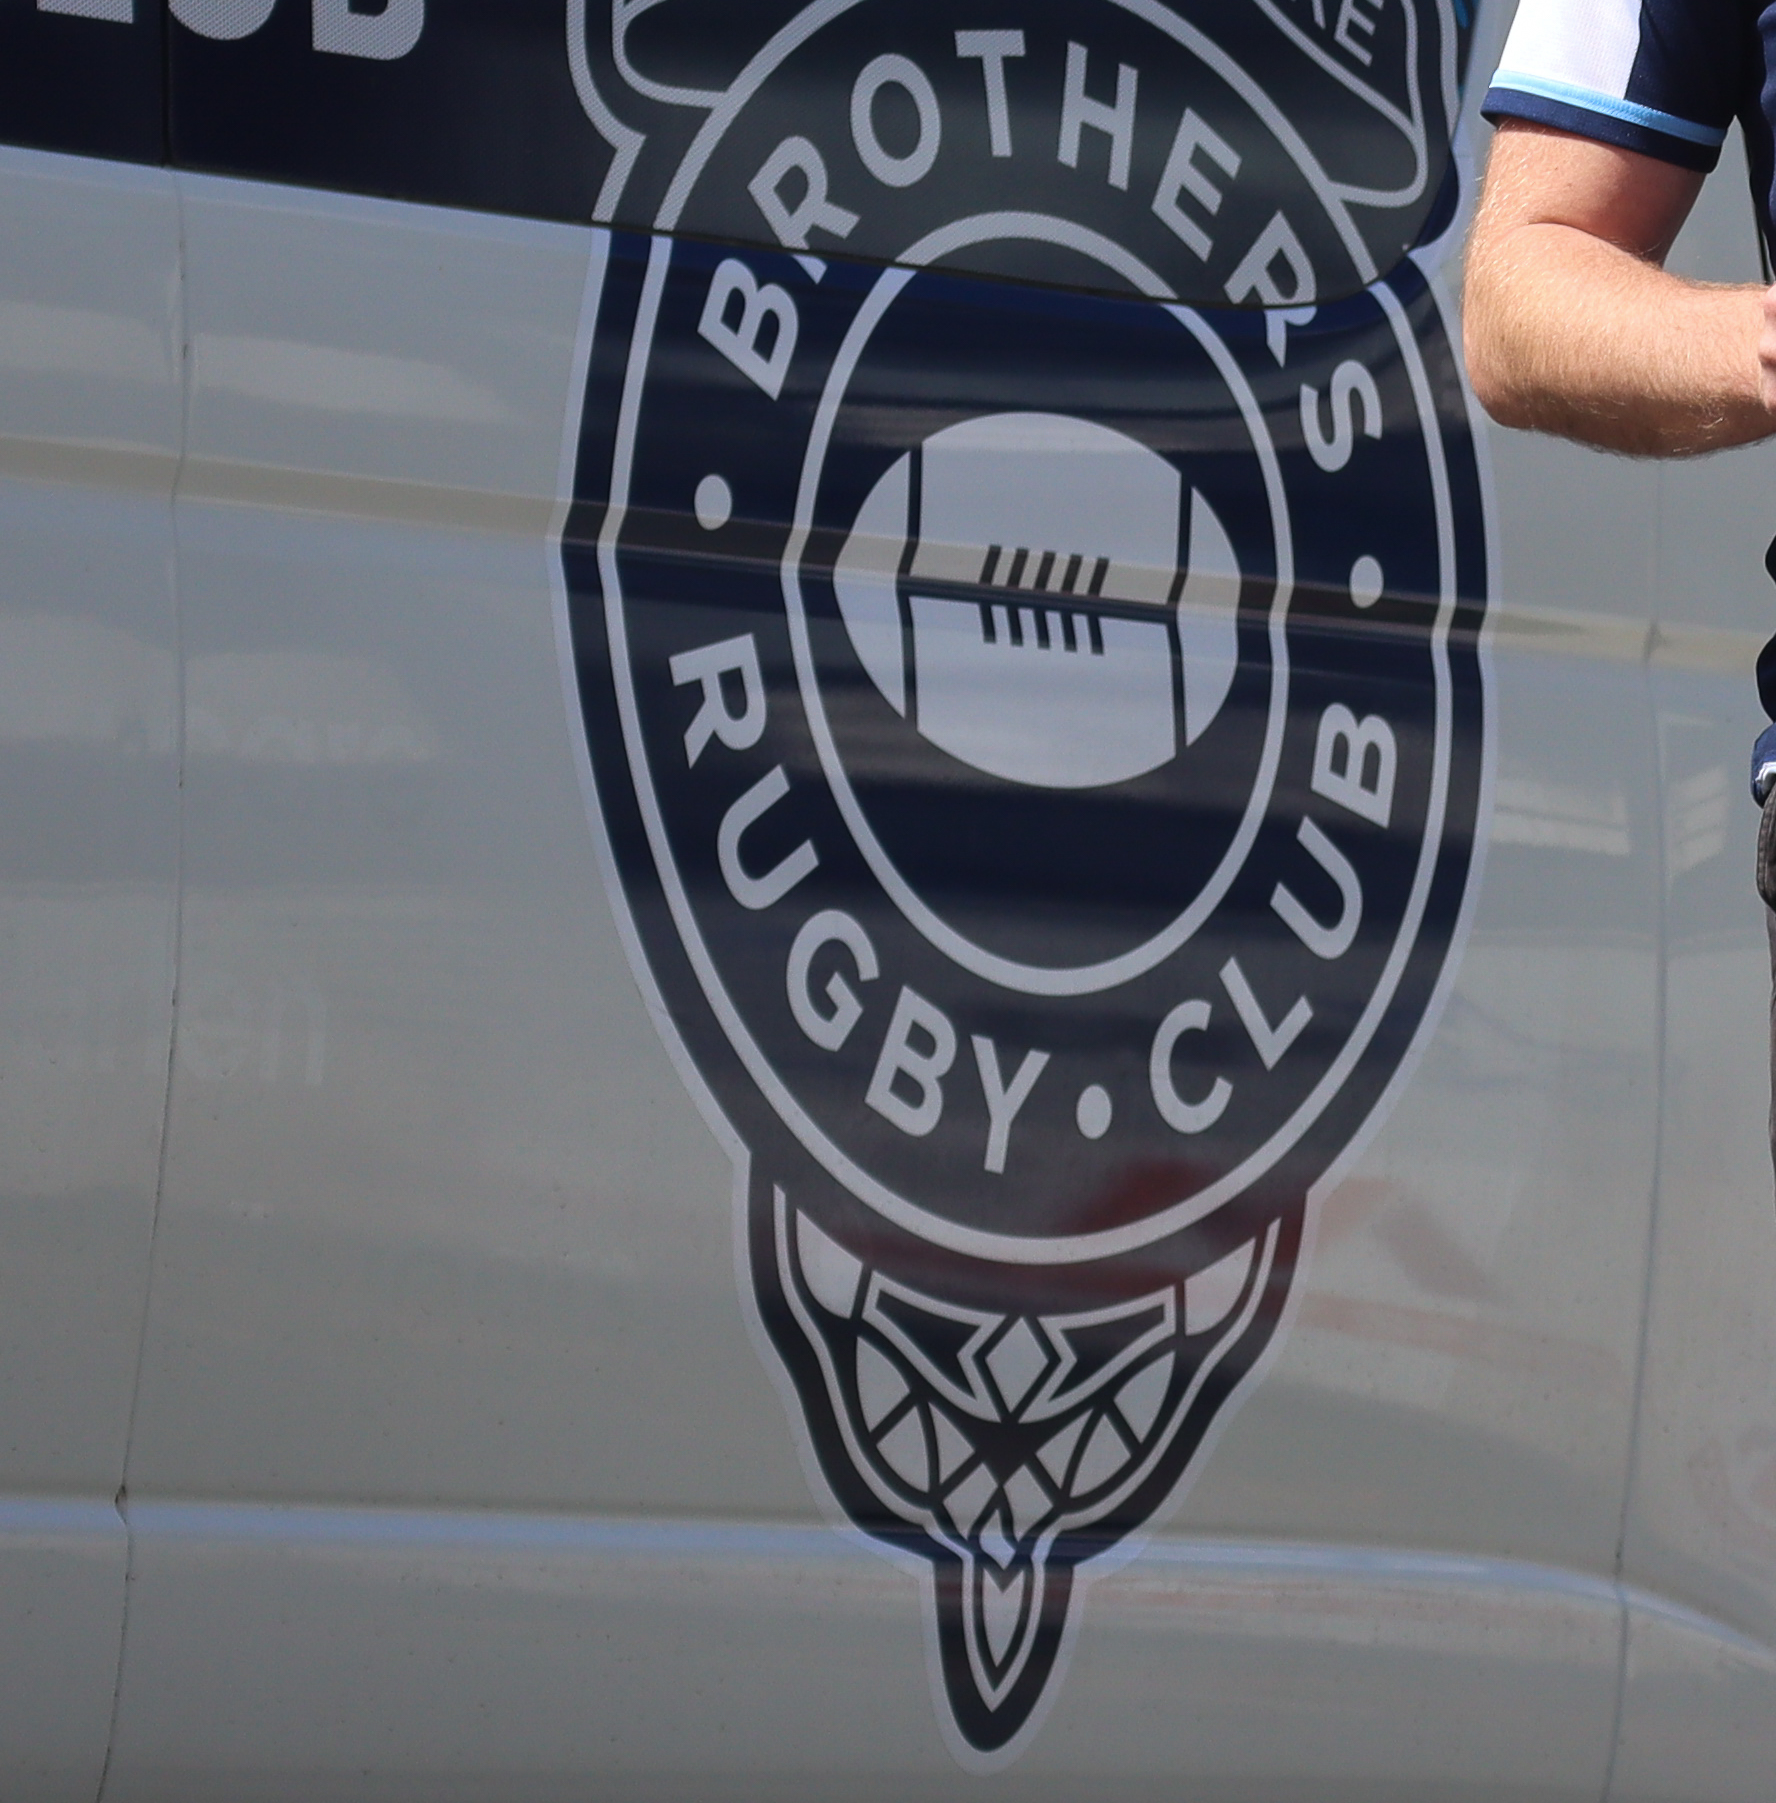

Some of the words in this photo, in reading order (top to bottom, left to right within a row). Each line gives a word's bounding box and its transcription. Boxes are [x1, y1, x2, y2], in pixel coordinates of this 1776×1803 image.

[697, 29, 1383, 472] BROTHERS
[668, 632, 1050, 1175] RUGBY
[1149, 701, 1398, 1136] CLUB
